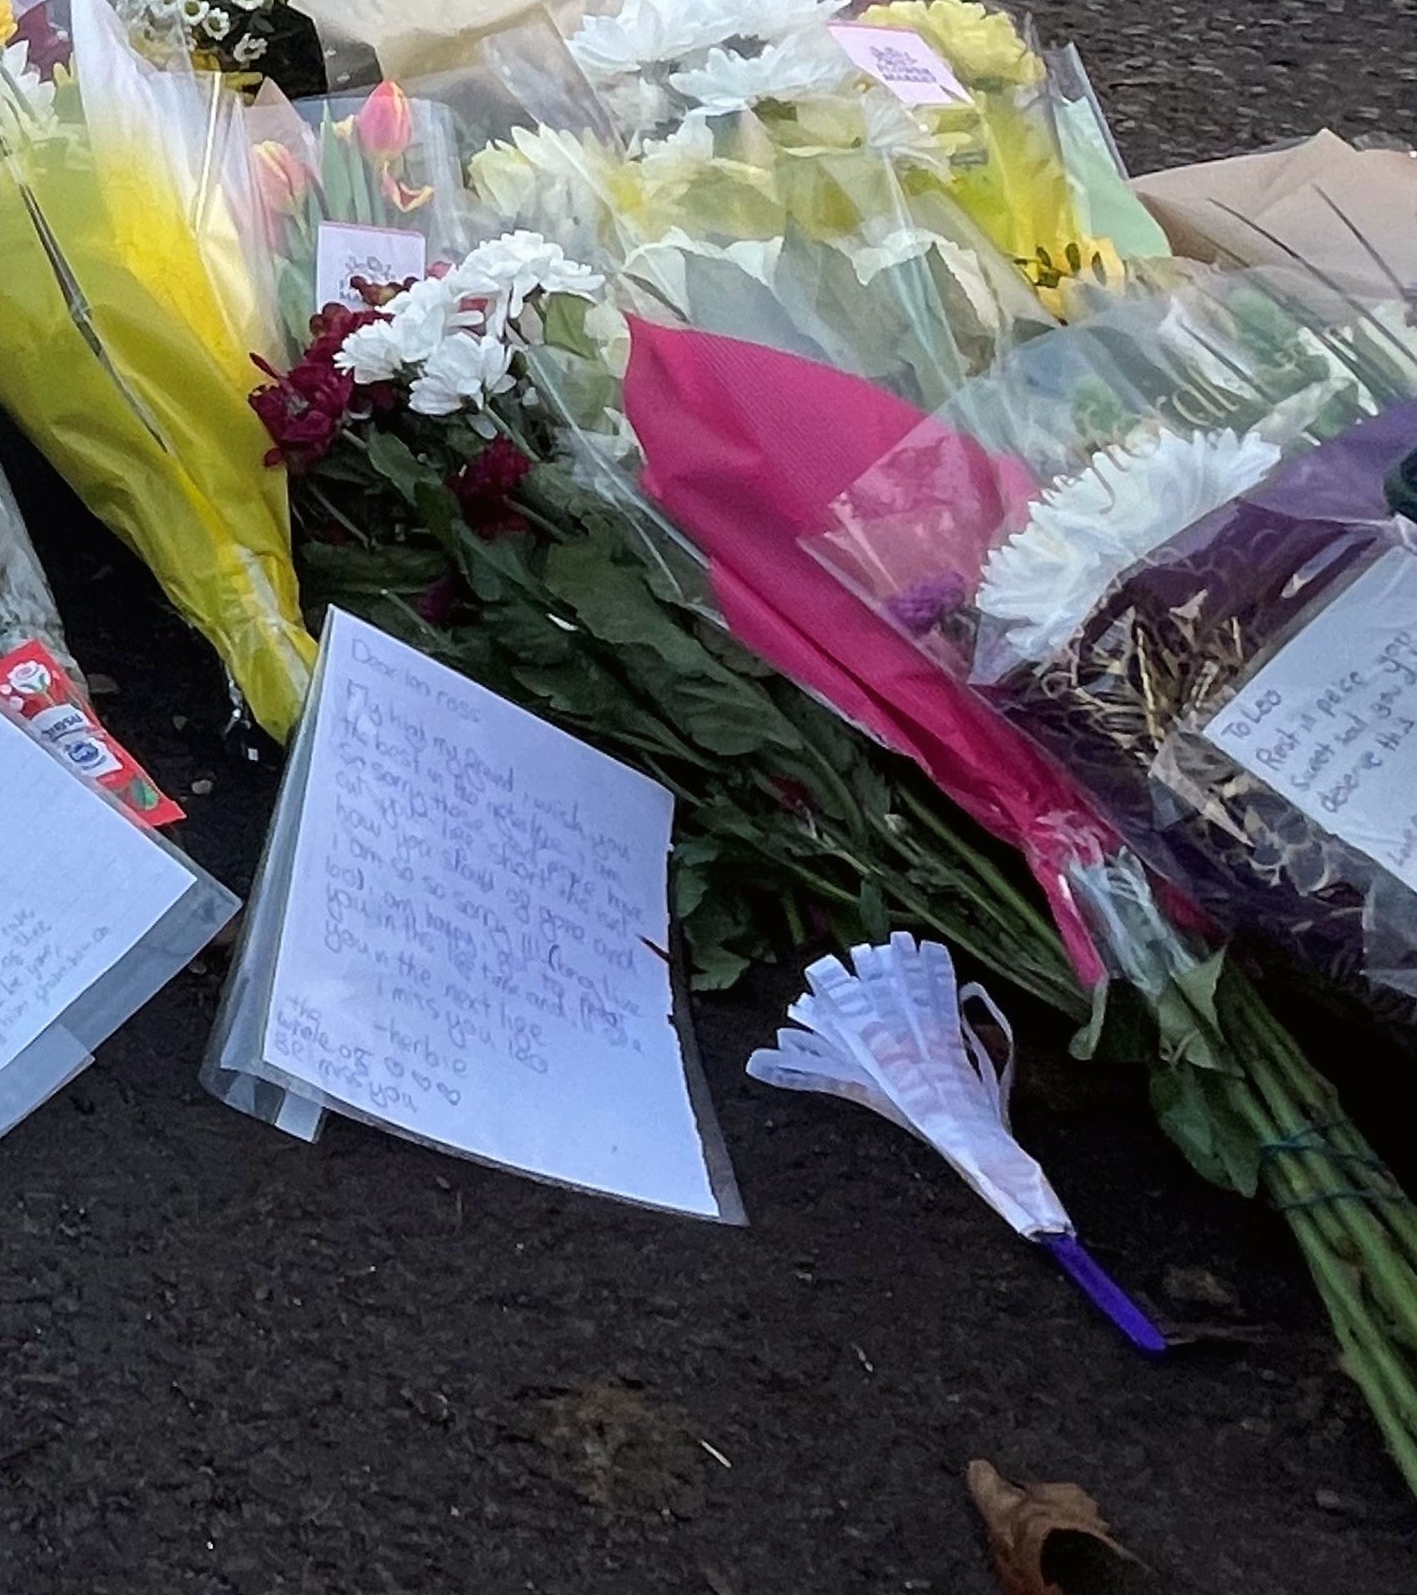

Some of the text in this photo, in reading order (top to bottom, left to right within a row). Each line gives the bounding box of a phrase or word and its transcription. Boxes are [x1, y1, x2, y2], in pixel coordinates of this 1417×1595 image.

[1221, 688, 1283, 740] To Leo
[1254, 726, 1301, 773] Rest
[431, 735, 459, 774] my
[589, 832, 632, 864] you
[348, 835, 511, 955] am so so sorry
[394, 832, 433, 865] you
[592, 937, 638, 978] and
[322, 918, 369, 956] you
[396, 950, 433, 989] the
[443, 982, 493, 1017] next
[390, 985, 494, 1052] miss you
